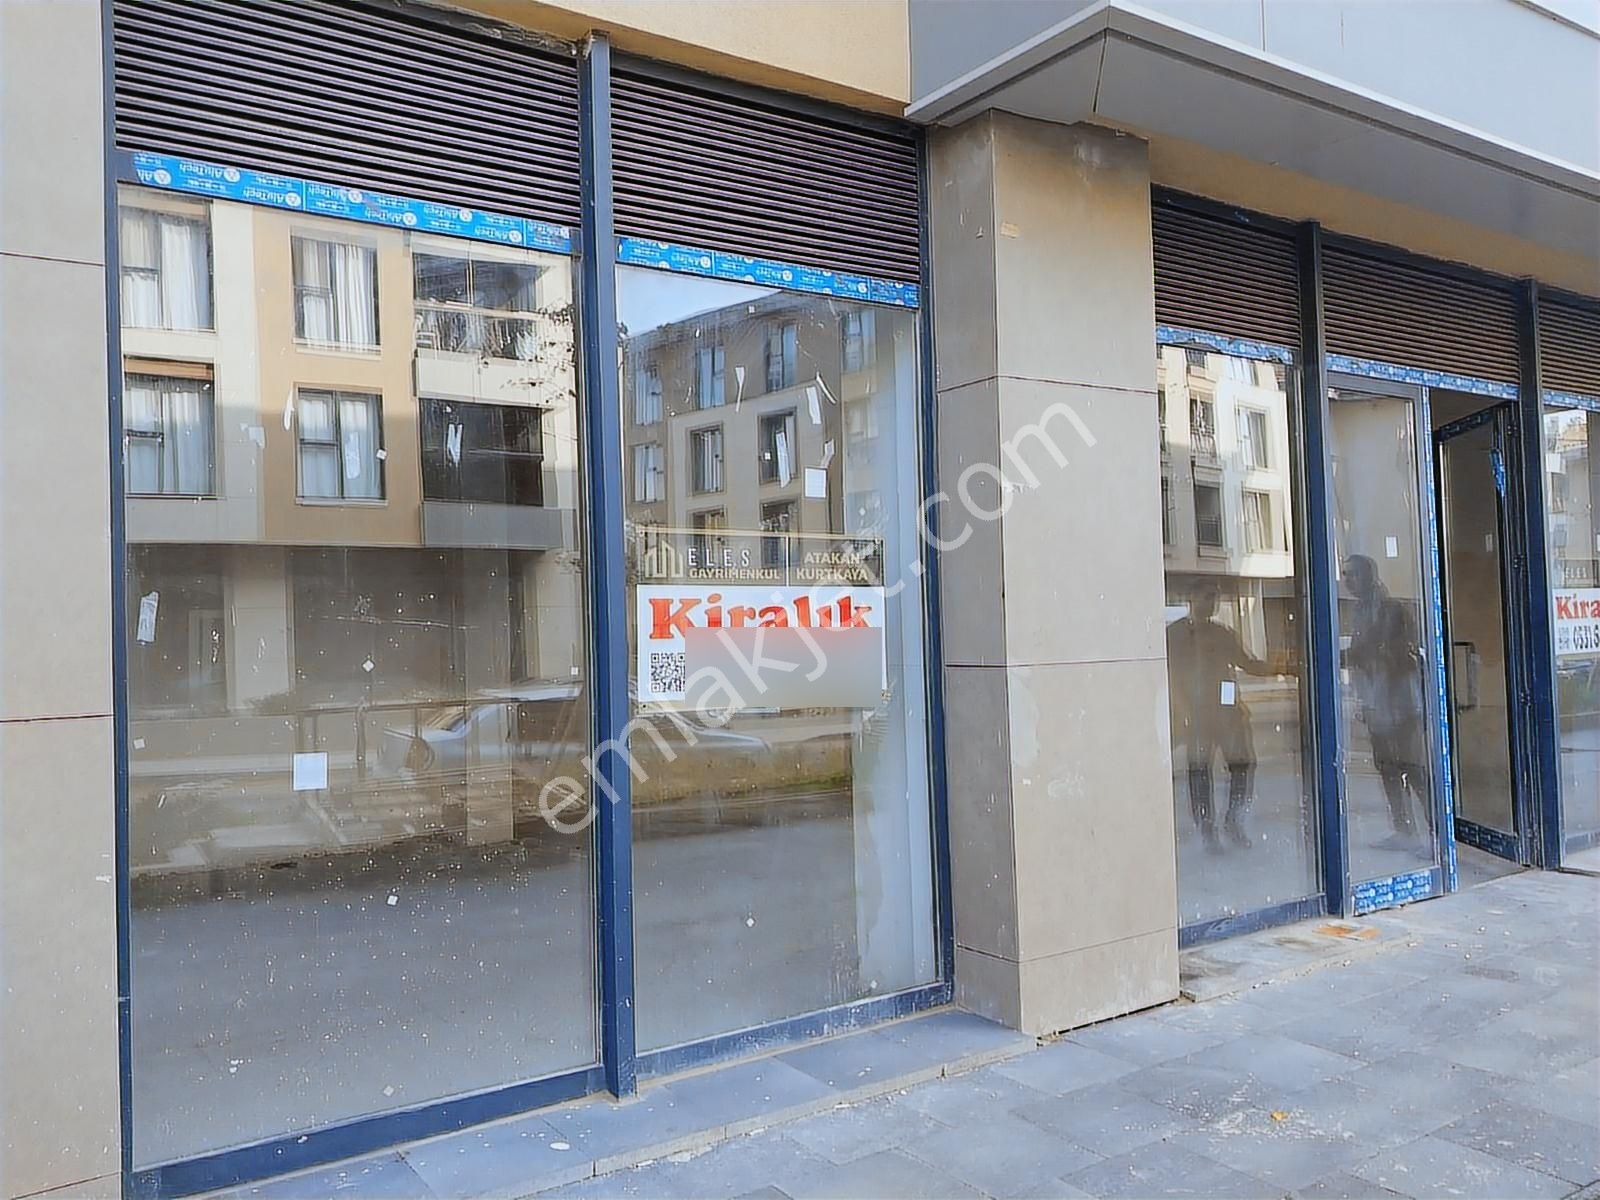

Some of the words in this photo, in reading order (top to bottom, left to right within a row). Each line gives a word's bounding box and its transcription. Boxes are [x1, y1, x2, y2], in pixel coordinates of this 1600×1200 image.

[687, 547, 751, 567] ELES
[803, 552, 860, 565] ATAKAN
[796, 567, 868, 581] KURTKAYA
